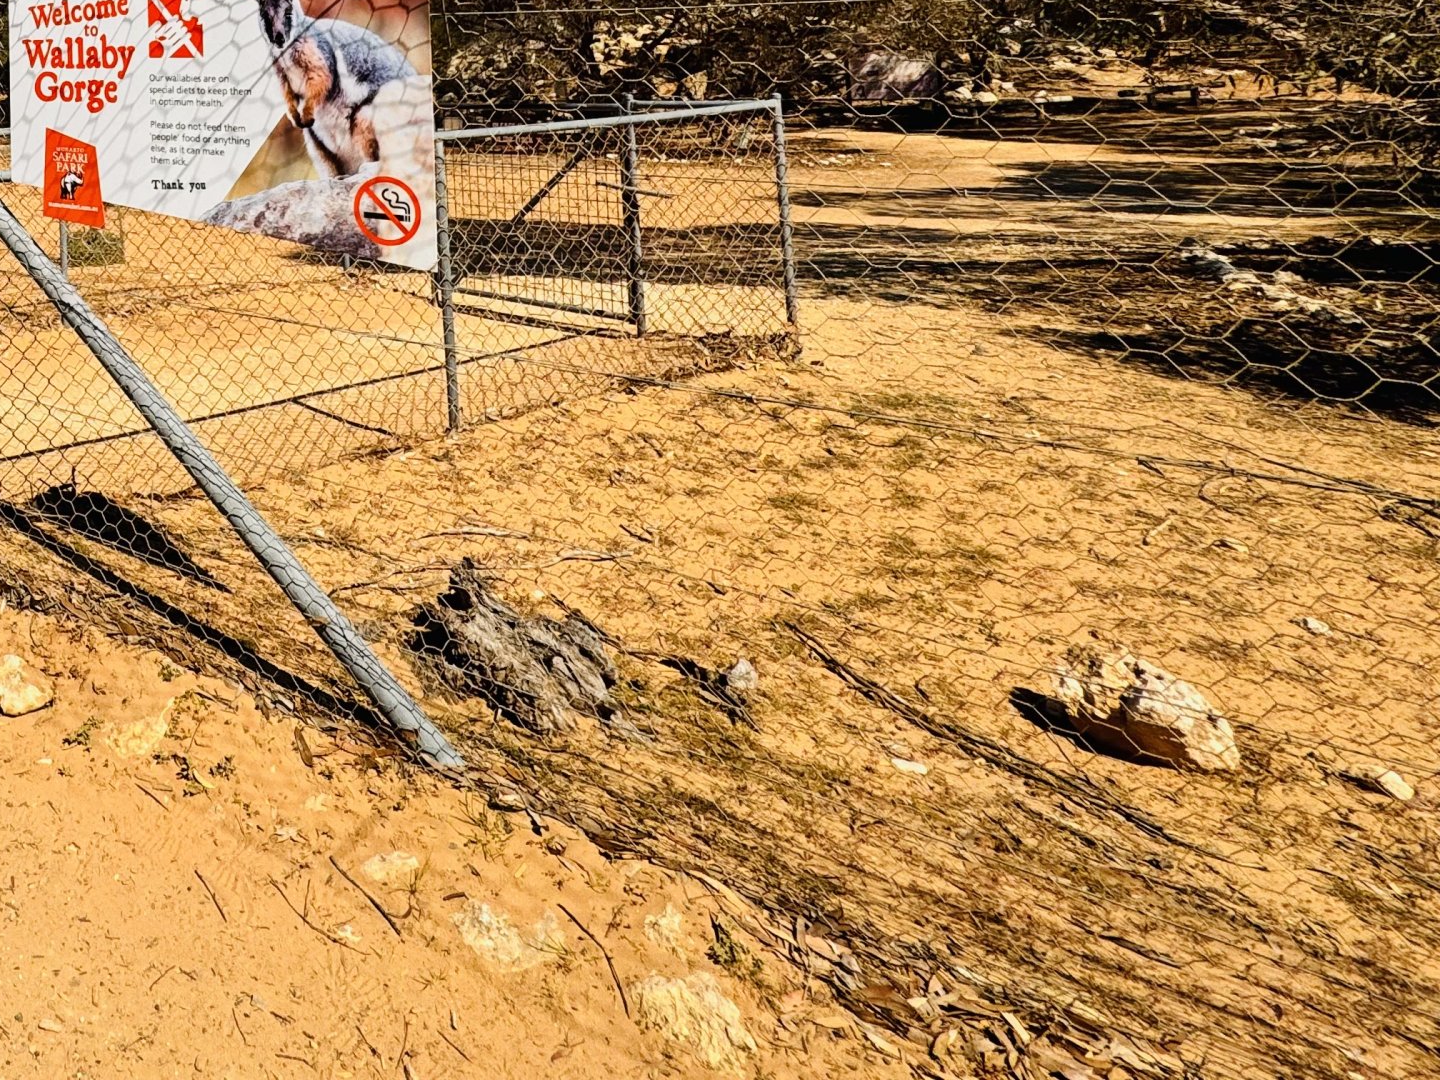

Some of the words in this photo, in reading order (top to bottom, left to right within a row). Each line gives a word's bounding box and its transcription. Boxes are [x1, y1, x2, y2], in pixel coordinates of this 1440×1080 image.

[84, 24, 99, 37] to
[22, 34, 136, 80] Wallaby
[149, 73, 163, 82] Our
[165, 73, 201, 83] wallabies
[203, 75, 216, 83] are
[34, 71, 118, 113] Gorge
[149, 86, 174, 94] special
[176, 86, 195, 94] diets
[197, 87, 205, 95] to
[207, 86, 227, 96] keep
[230, 87, 252, 95] them
[149, 96, 157, 105] in
[158, 97, 194, 107] optimum
[196, 98, 224, 107] health.
[150, 120, 173, 129] Please
[175, 121, 186, 130] do
[188, 123, 201, 131] not
[204, 122, 221, 131] feed
[224, 124, 246, 133] them
[182, 133, 200, 142] food
[213, 136, 250, 147] anything
[150, 144, 167, 154] else,
[180, 145, 185, 154] it
[186, 147, 200, 155] can
[202, 147, 225, 156] make
[53, 151, 88, 163] SAFARI
[150, 156, 170, 165] them
[56, 161, 85, 174] PARK
[151, 178, 184, 190] Thank
[189, 181, 206, 193] you
